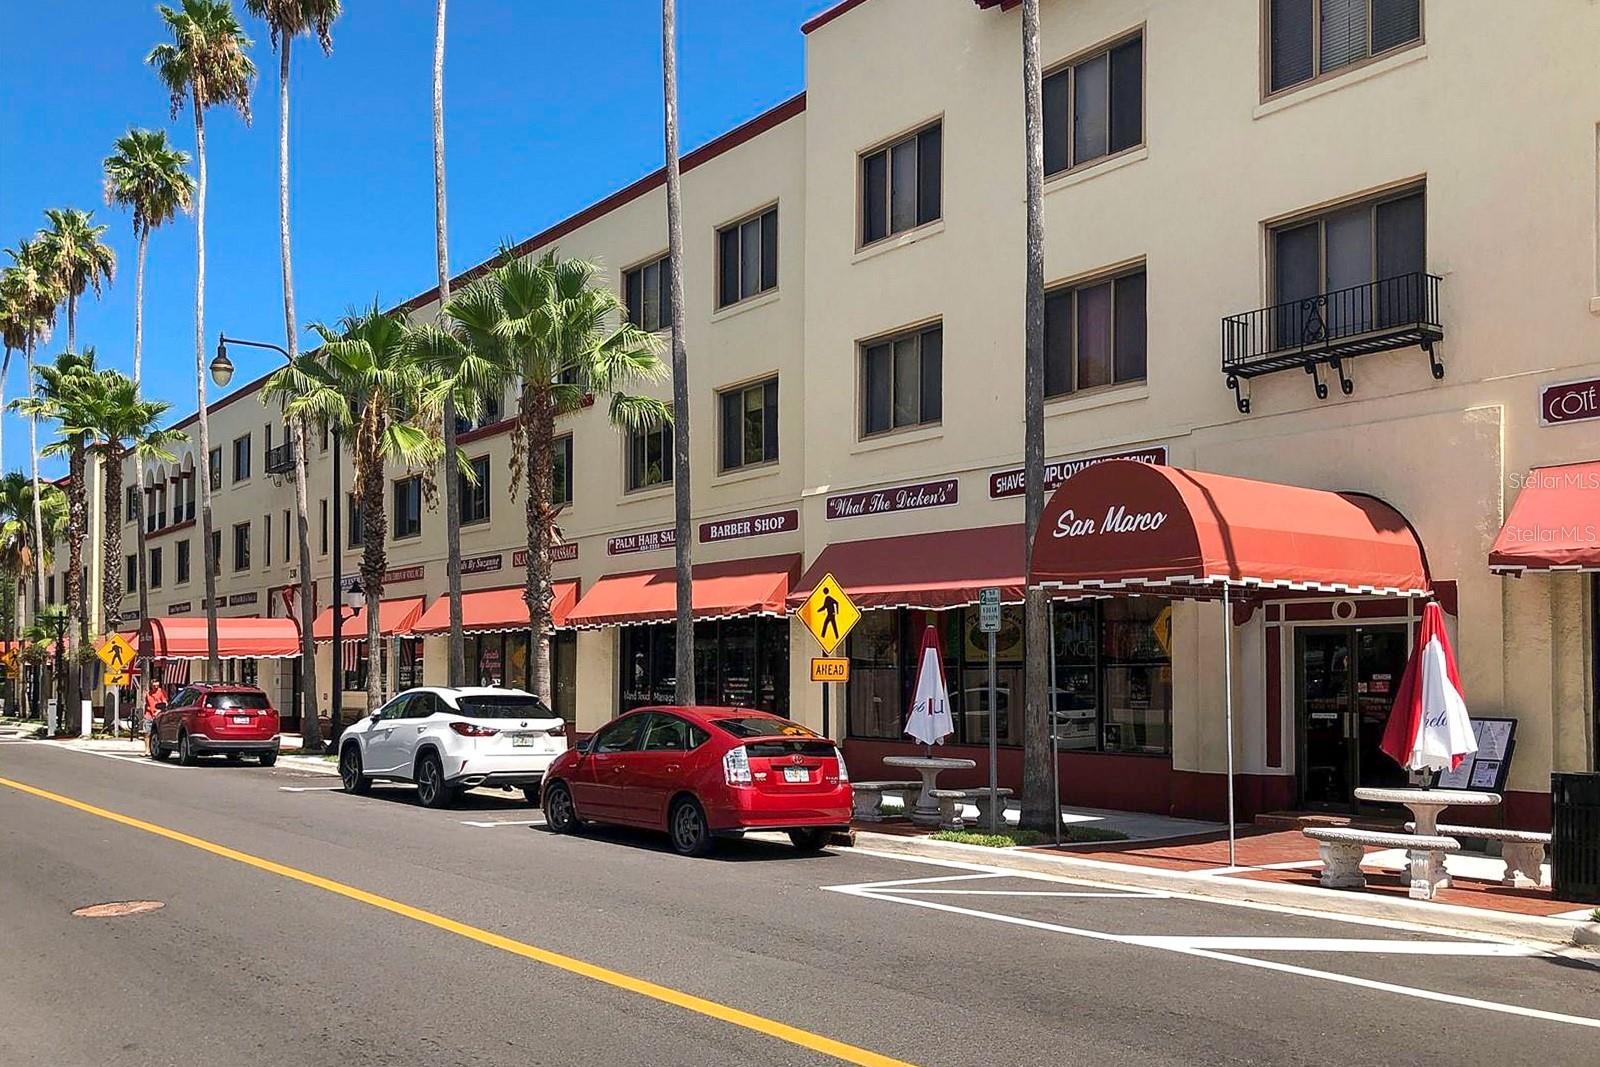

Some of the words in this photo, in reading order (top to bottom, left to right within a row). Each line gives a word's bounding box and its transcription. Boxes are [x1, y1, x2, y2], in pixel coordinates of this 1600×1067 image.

[1549, 386, 1598, 419] CÔTÉ
[996, 474, 1025, 494] SHAVE
[869, 492, 890, 512] The
[710, 521, 751, 538] BARBER
[754, 516, 785, 532] SHOP
[1052, 508, 1096, 538] San
[1099, 505, 1168, 535] Marco
[615, 537, 636, 550] PALM
[638, 533, 658, 546] HAIR
[660, 530, 677, 543] SAL
[816, 663, 845, 676] AHEAD
